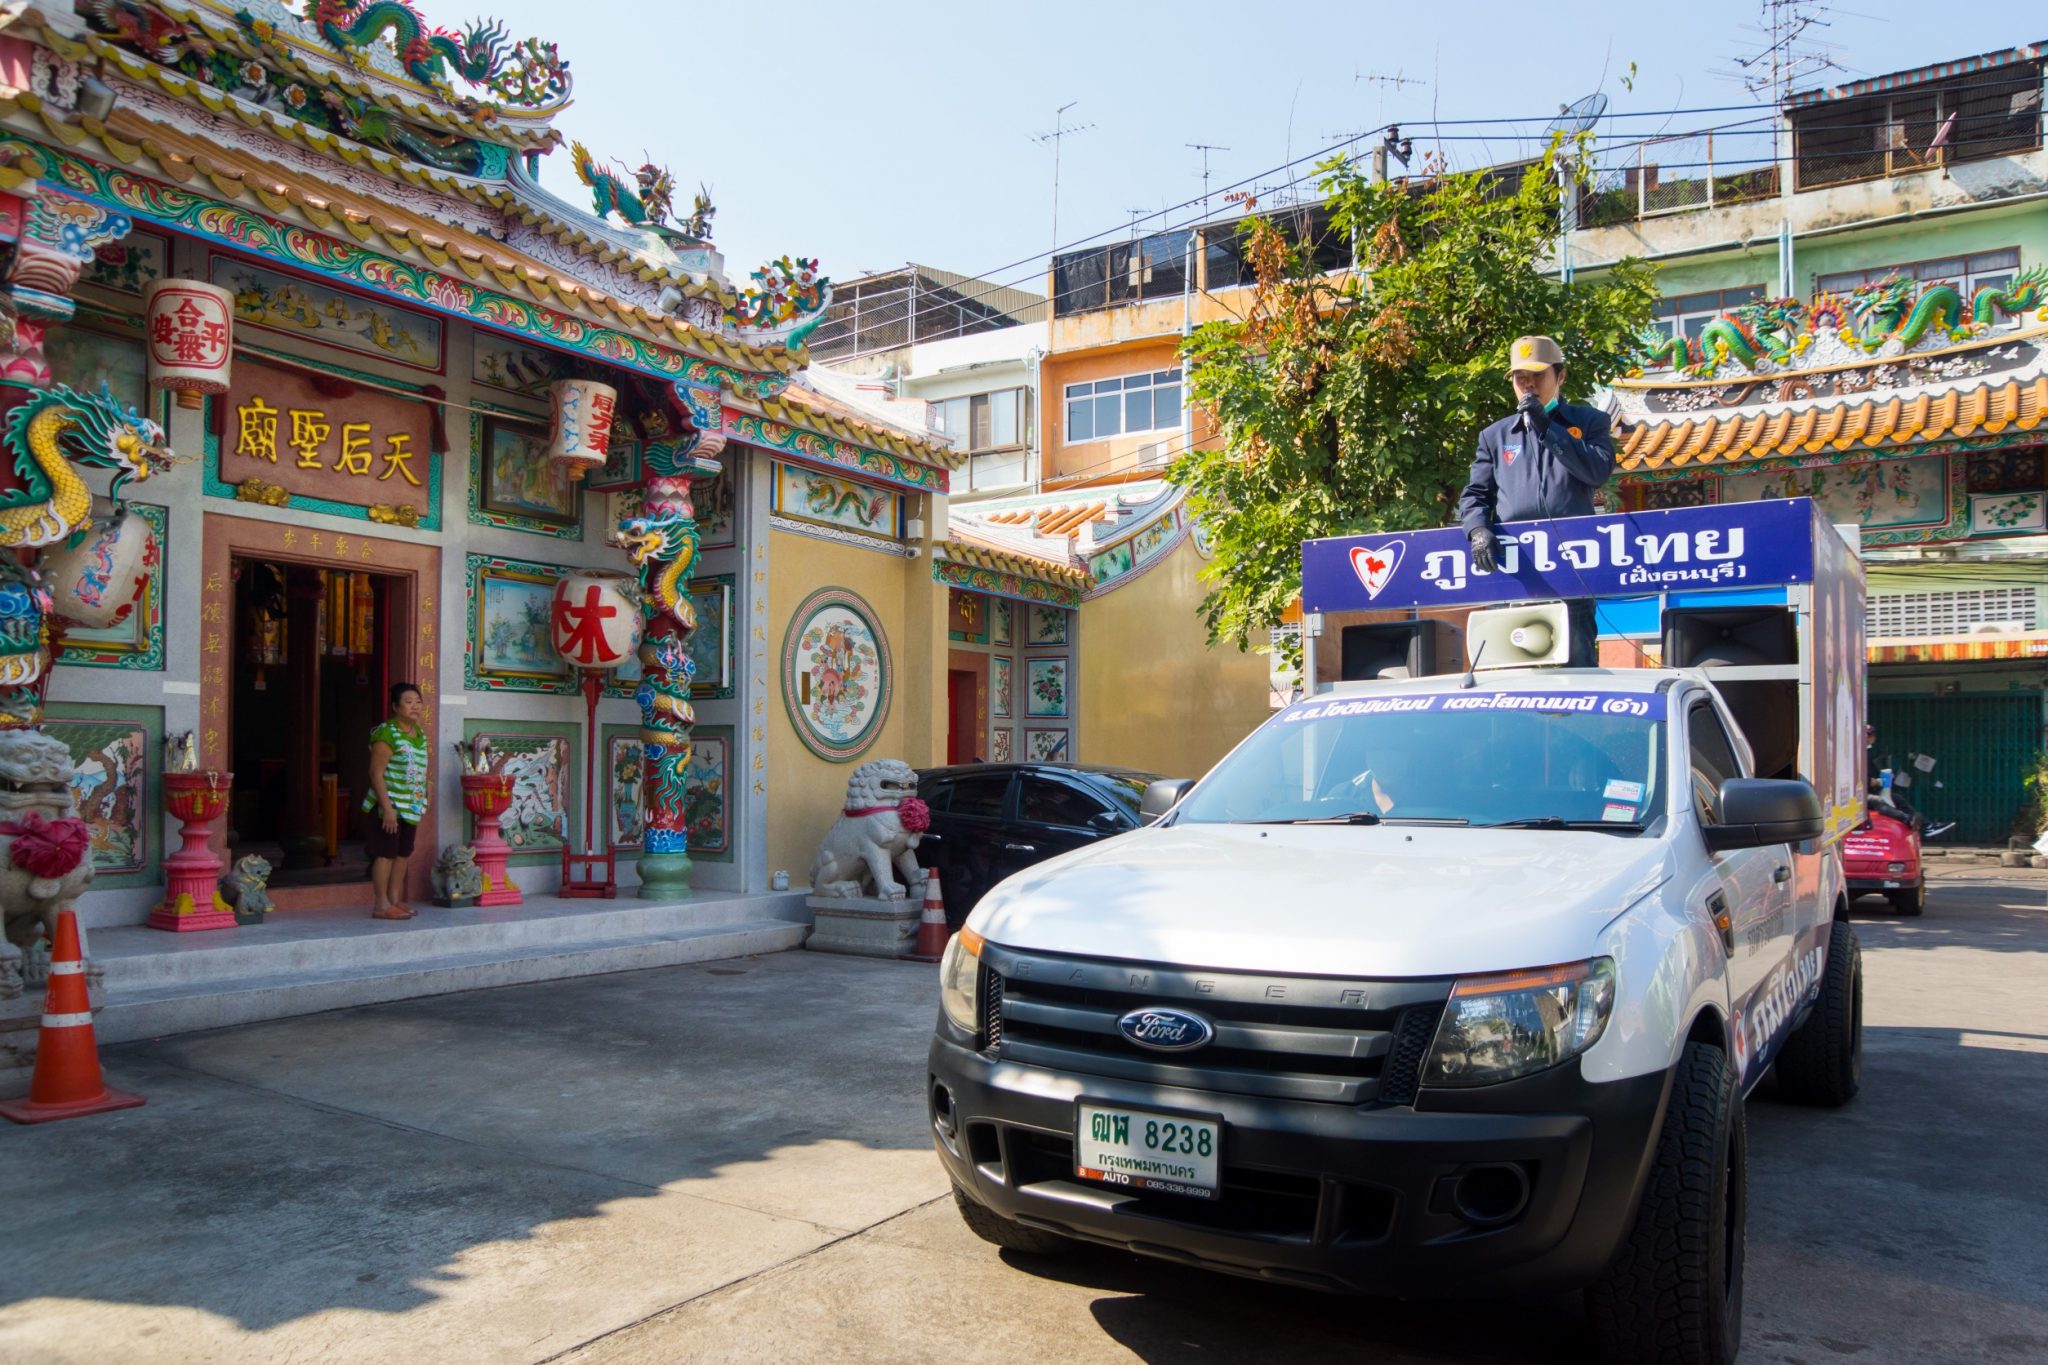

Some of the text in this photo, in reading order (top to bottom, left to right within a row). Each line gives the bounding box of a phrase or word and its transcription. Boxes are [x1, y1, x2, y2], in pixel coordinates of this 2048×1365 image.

[1619, 560, 1747, 586] (ฝั่งธนบุรี)
[1014, 960, 1369, 1006] RANGER
[1134, 1012, 1188, 1041] Ford
[1144, 1120, 1212, 1157] 8238
[1098, 1153, 1196, 1179] กรุงเทพมหานคร
